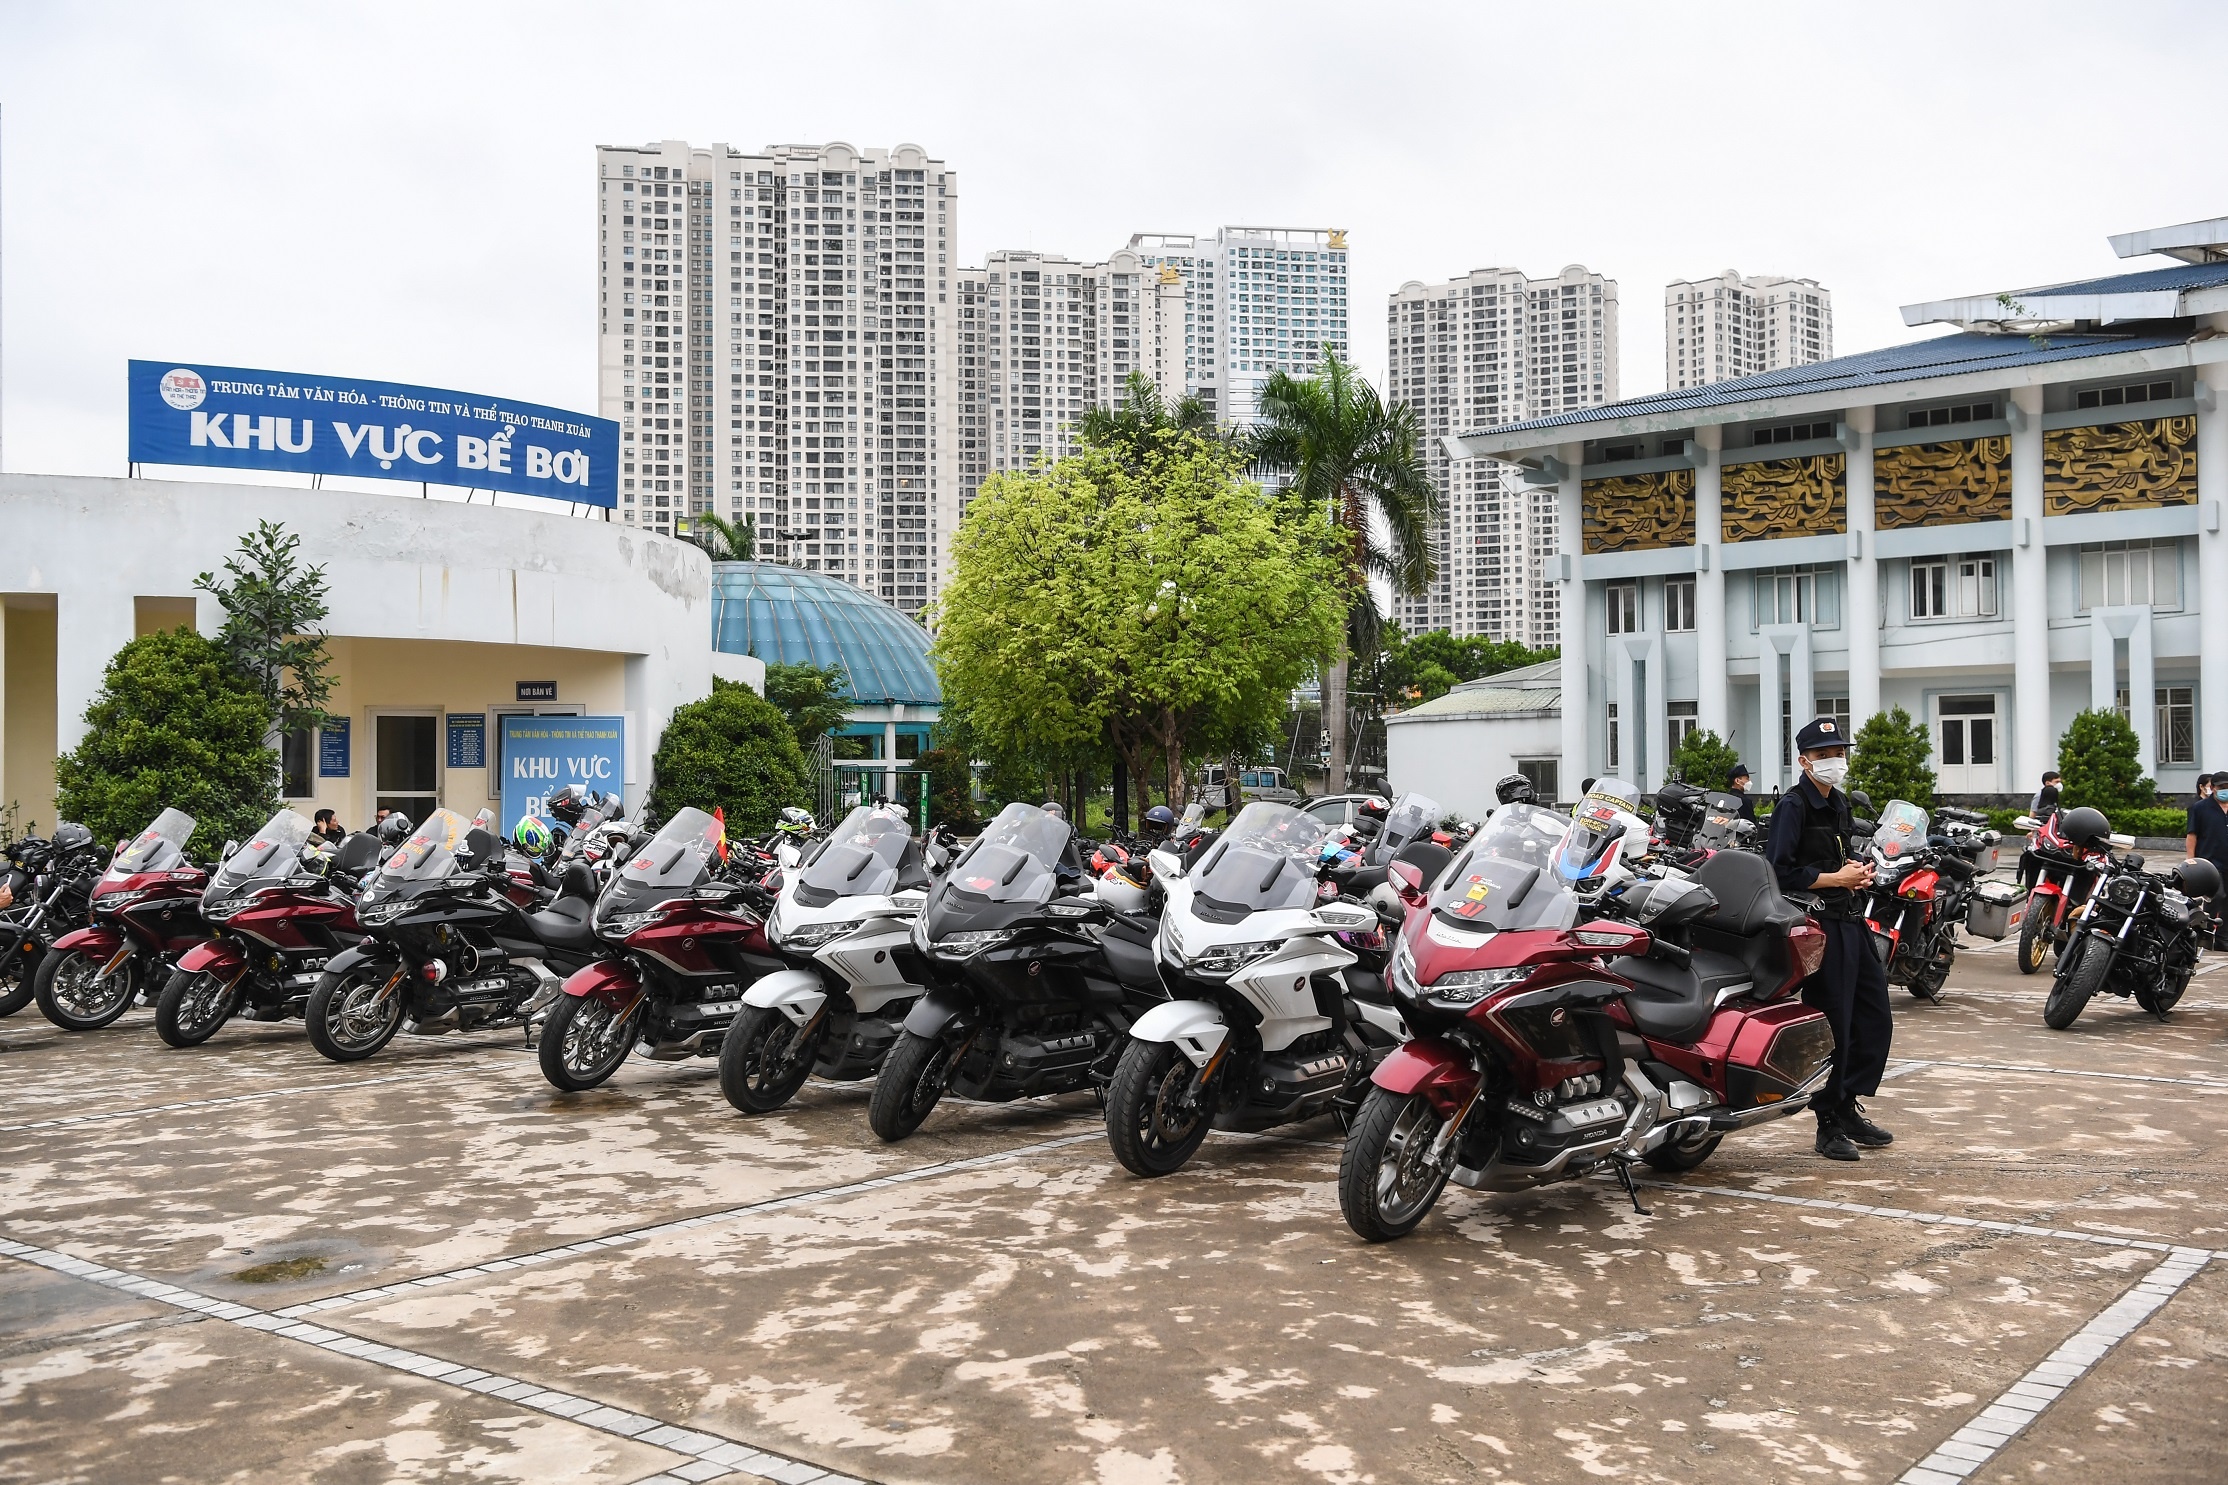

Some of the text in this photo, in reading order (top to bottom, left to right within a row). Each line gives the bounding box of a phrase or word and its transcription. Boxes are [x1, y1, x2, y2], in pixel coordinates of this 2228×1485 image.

[211, 380, 264, 396] TRUNG
[267, 382, 300, 399] TÂM
[303, 386, 334, 402] VĂN
[338, 389, 368, 405] HÓA
[379, 394, 425, 412] THÔNG
[428, 400, 450, 415] TIN
[454, 403, 470, 417] VÀ
[473, 403, 497, 421] THỂ
[499, 411, 529, 426] THAO
[530, 416, 564, 433] THANH
[565, 423, 591, 438] XUÂN
[190, 410, 590, 487] KHU VỰC BỂ BƠI
[513, 754, 611, 785] KHU VỰC
[1605, 795, 1635, 812] CAPTAIN
[1583, 1129, 1608, 1140] HONDA
